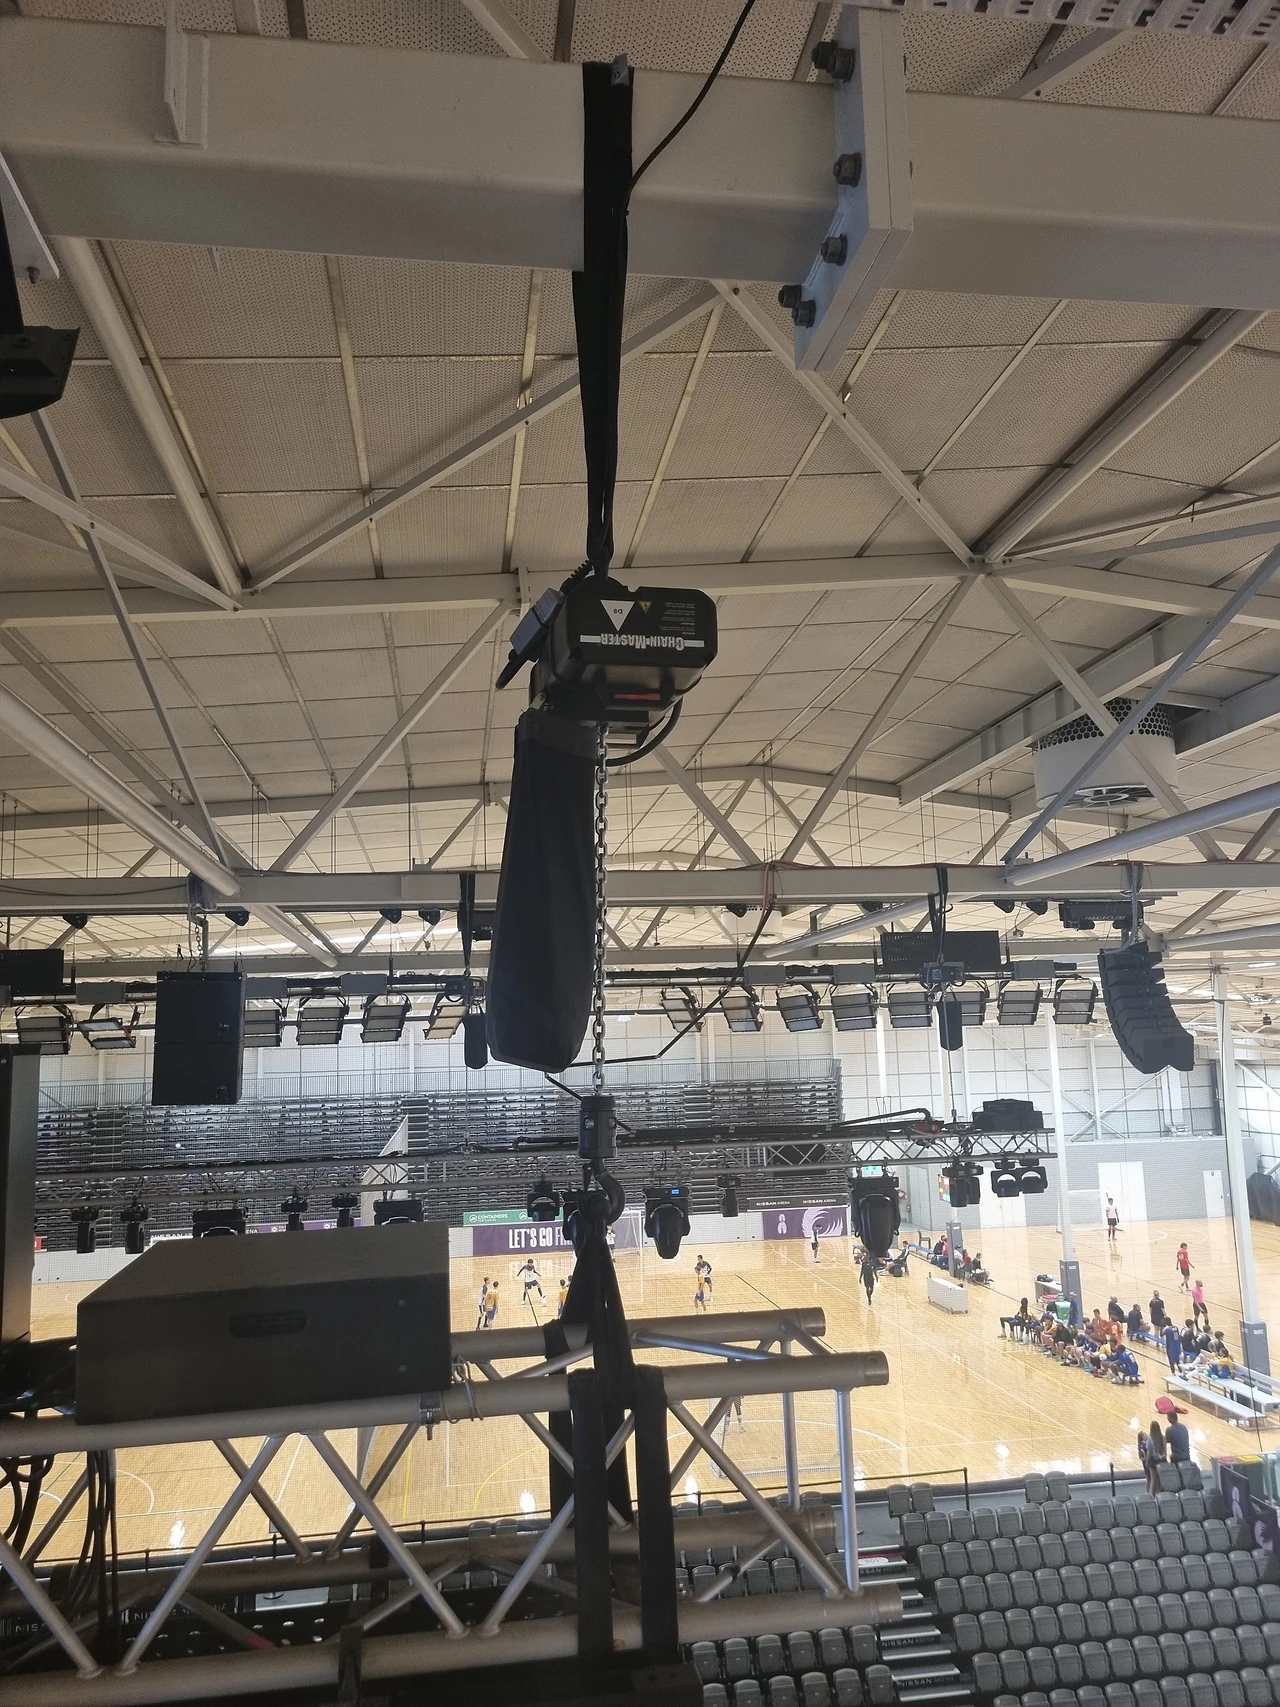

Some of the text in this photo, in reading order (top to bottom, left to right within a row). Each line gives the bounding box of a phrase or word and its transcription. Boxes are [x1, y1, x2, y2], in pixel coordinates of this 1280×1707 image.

[508, 1227, 538, 1249] LET'S
[539, 1226, 553, 1247] GO
[860, 1567, 882, 1575] SSAN
[882, 1638, 914, 1647] NISSAN
[899, 1677, 932, 1687] NISSAN
